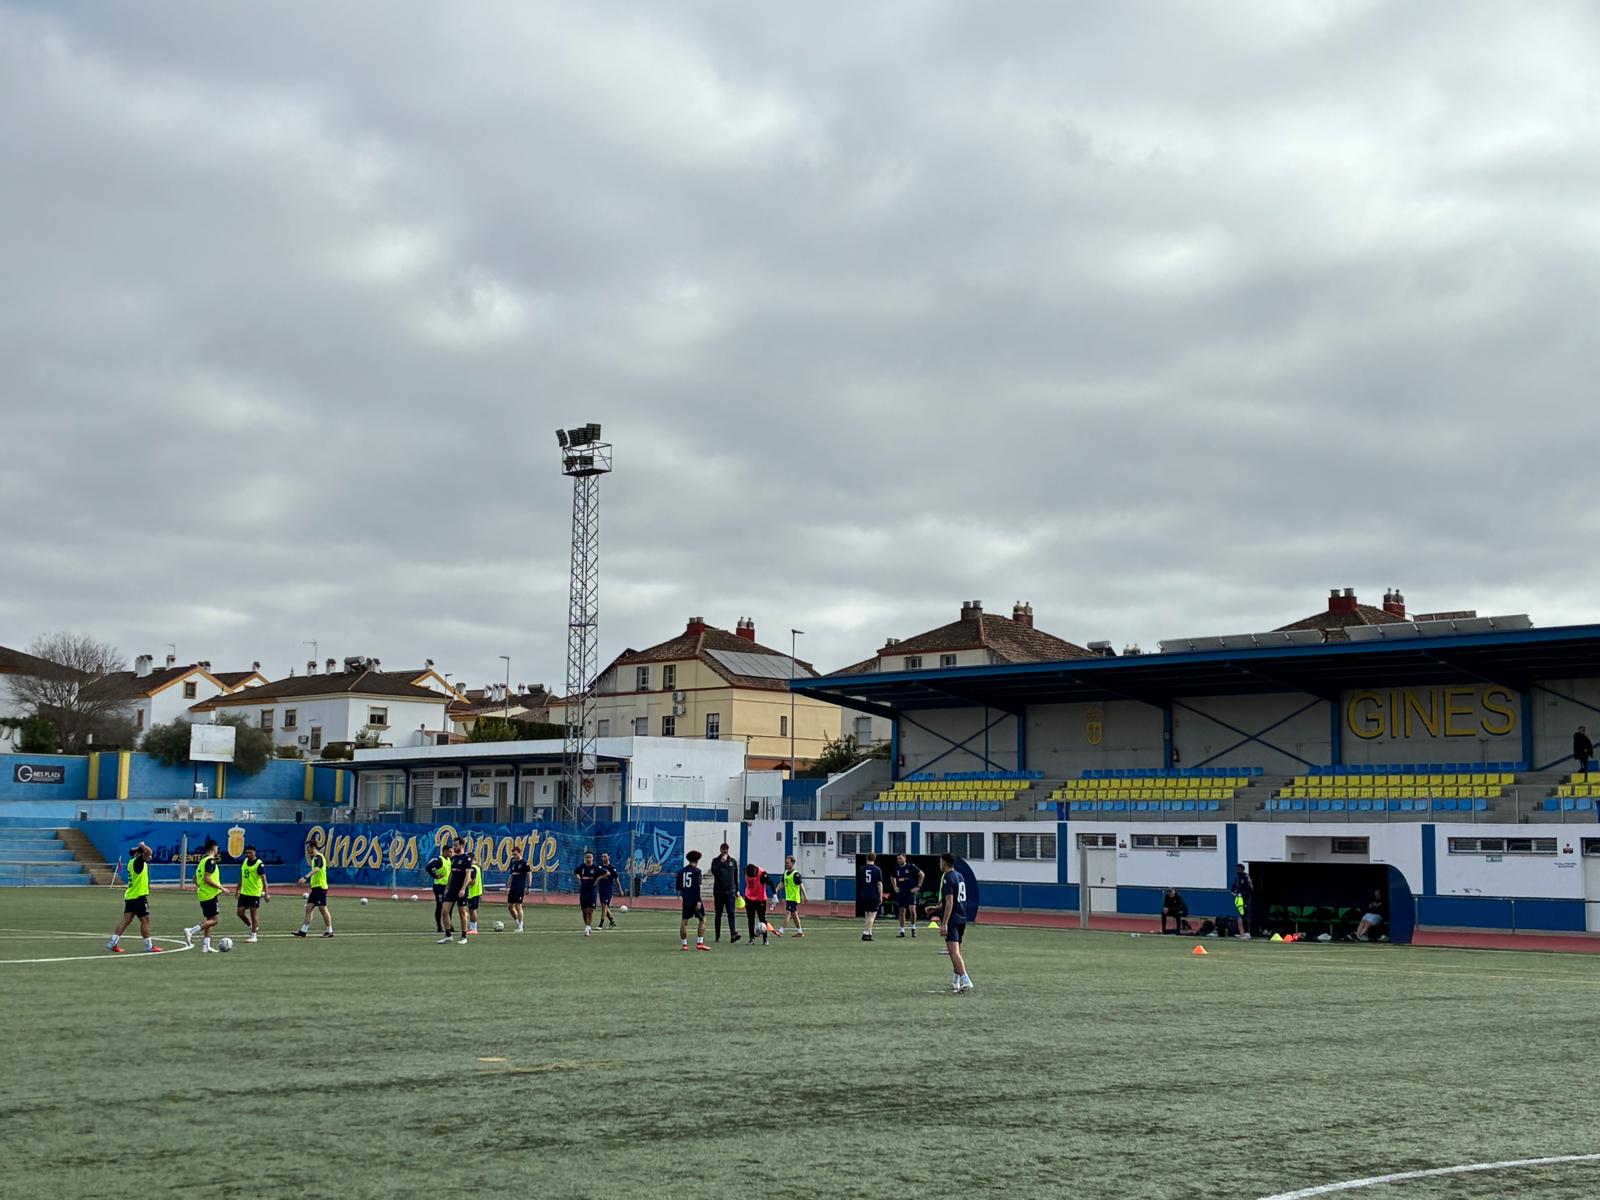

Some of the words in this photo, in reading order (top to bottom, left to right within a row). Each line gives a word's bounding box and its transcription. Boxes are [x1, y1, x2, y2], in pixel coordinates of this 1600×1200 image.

[1347, 685, 1517, 740] GINES
[682, 871, 693, 888] 15
[865, 869, 872, 883] 5
[957, 881, 967, 903] 19
